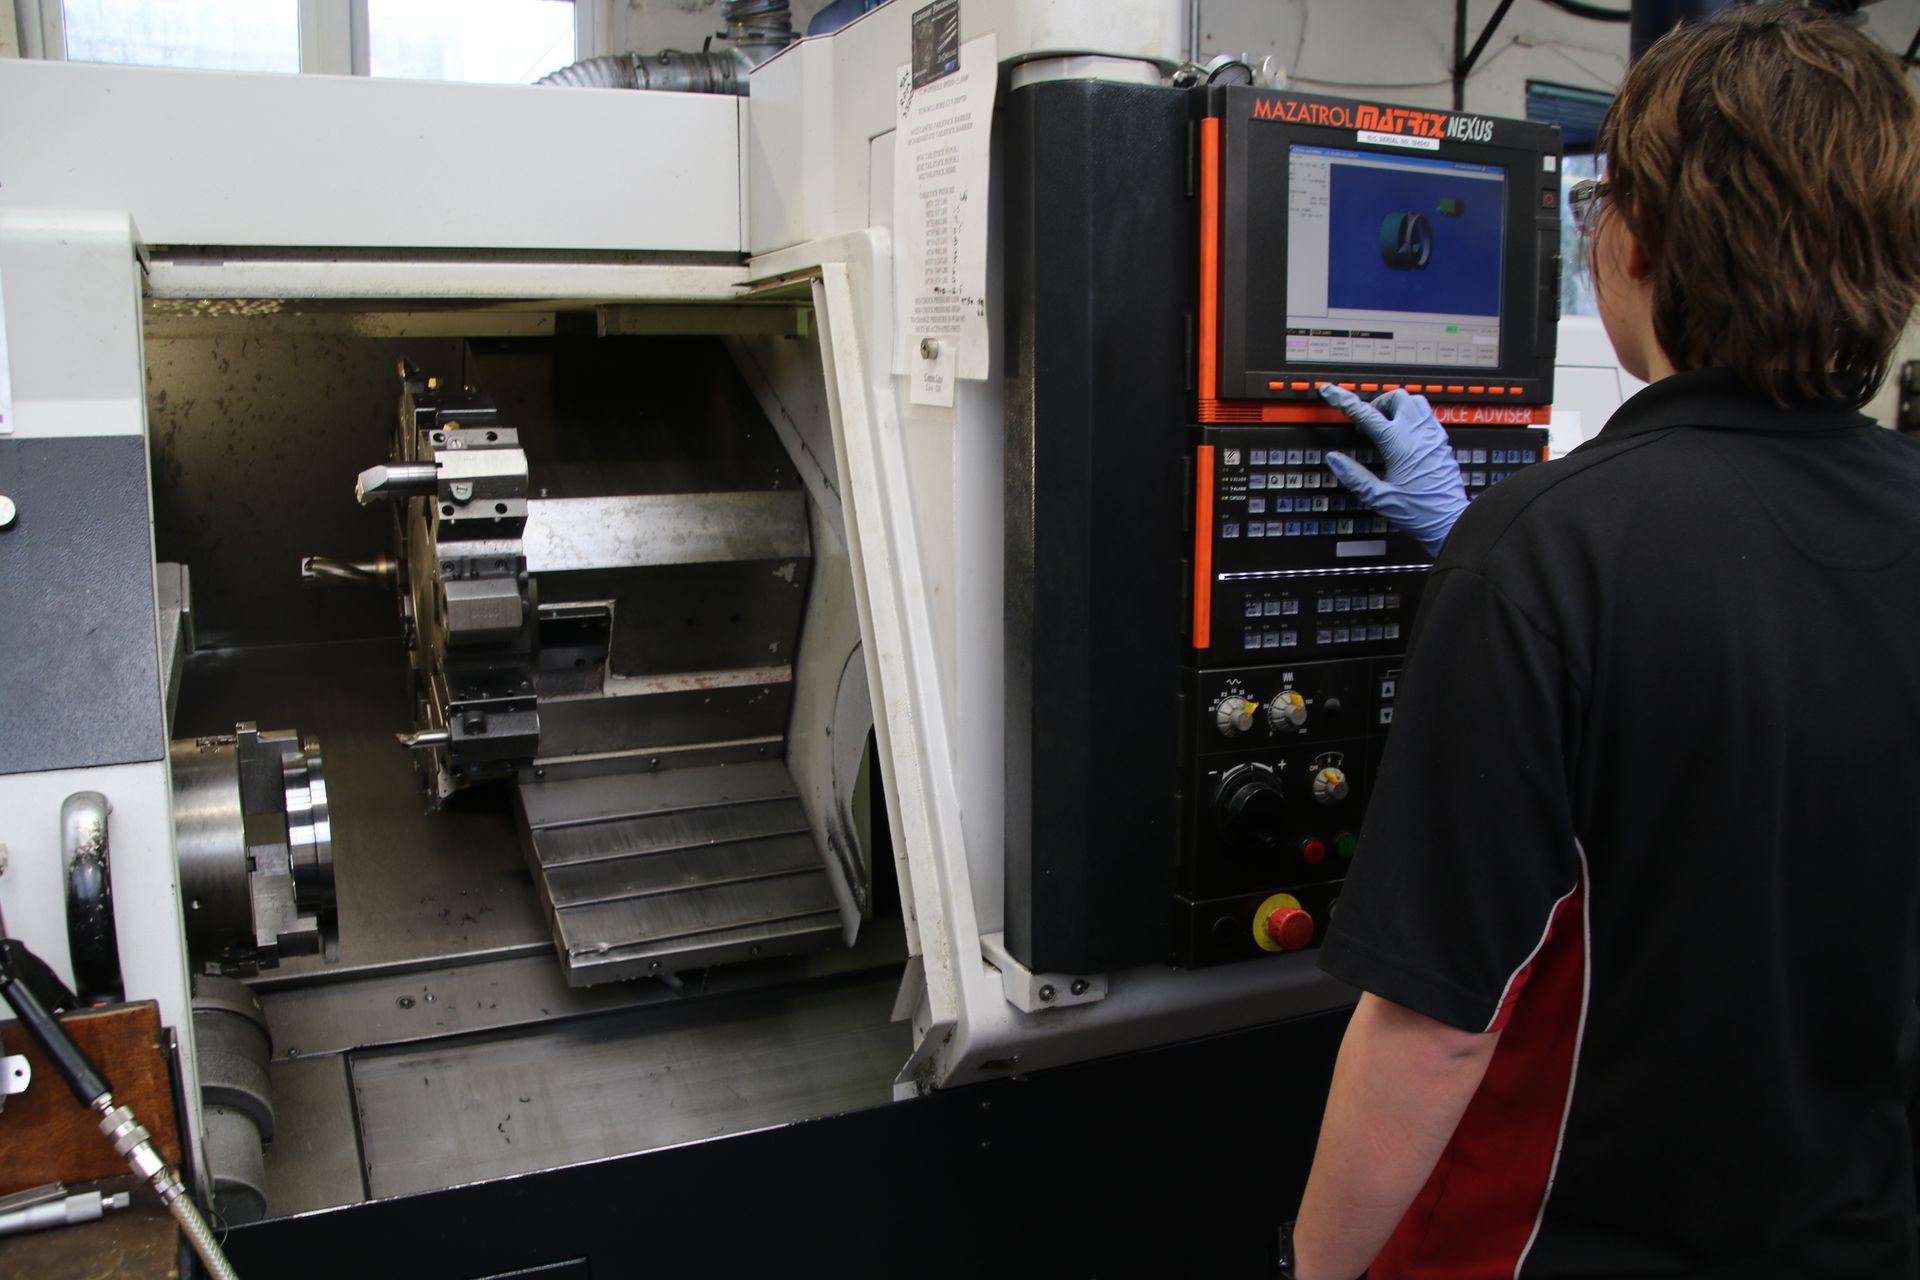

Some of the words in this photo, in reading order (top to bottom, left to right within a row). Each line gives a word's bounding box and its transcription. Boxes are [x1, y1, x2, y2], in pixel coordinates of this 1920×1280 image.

[1253, 98, 1354, 128] MAZATROL
[1447, 115, 1494, 142] NEXUS
[1432, 405, 1468, 423] OICE
[1473, 406, 1533, 424] ADVISER
[1270, 475, 1278, 485] Q
[1288, 475, 1297, 484] W
